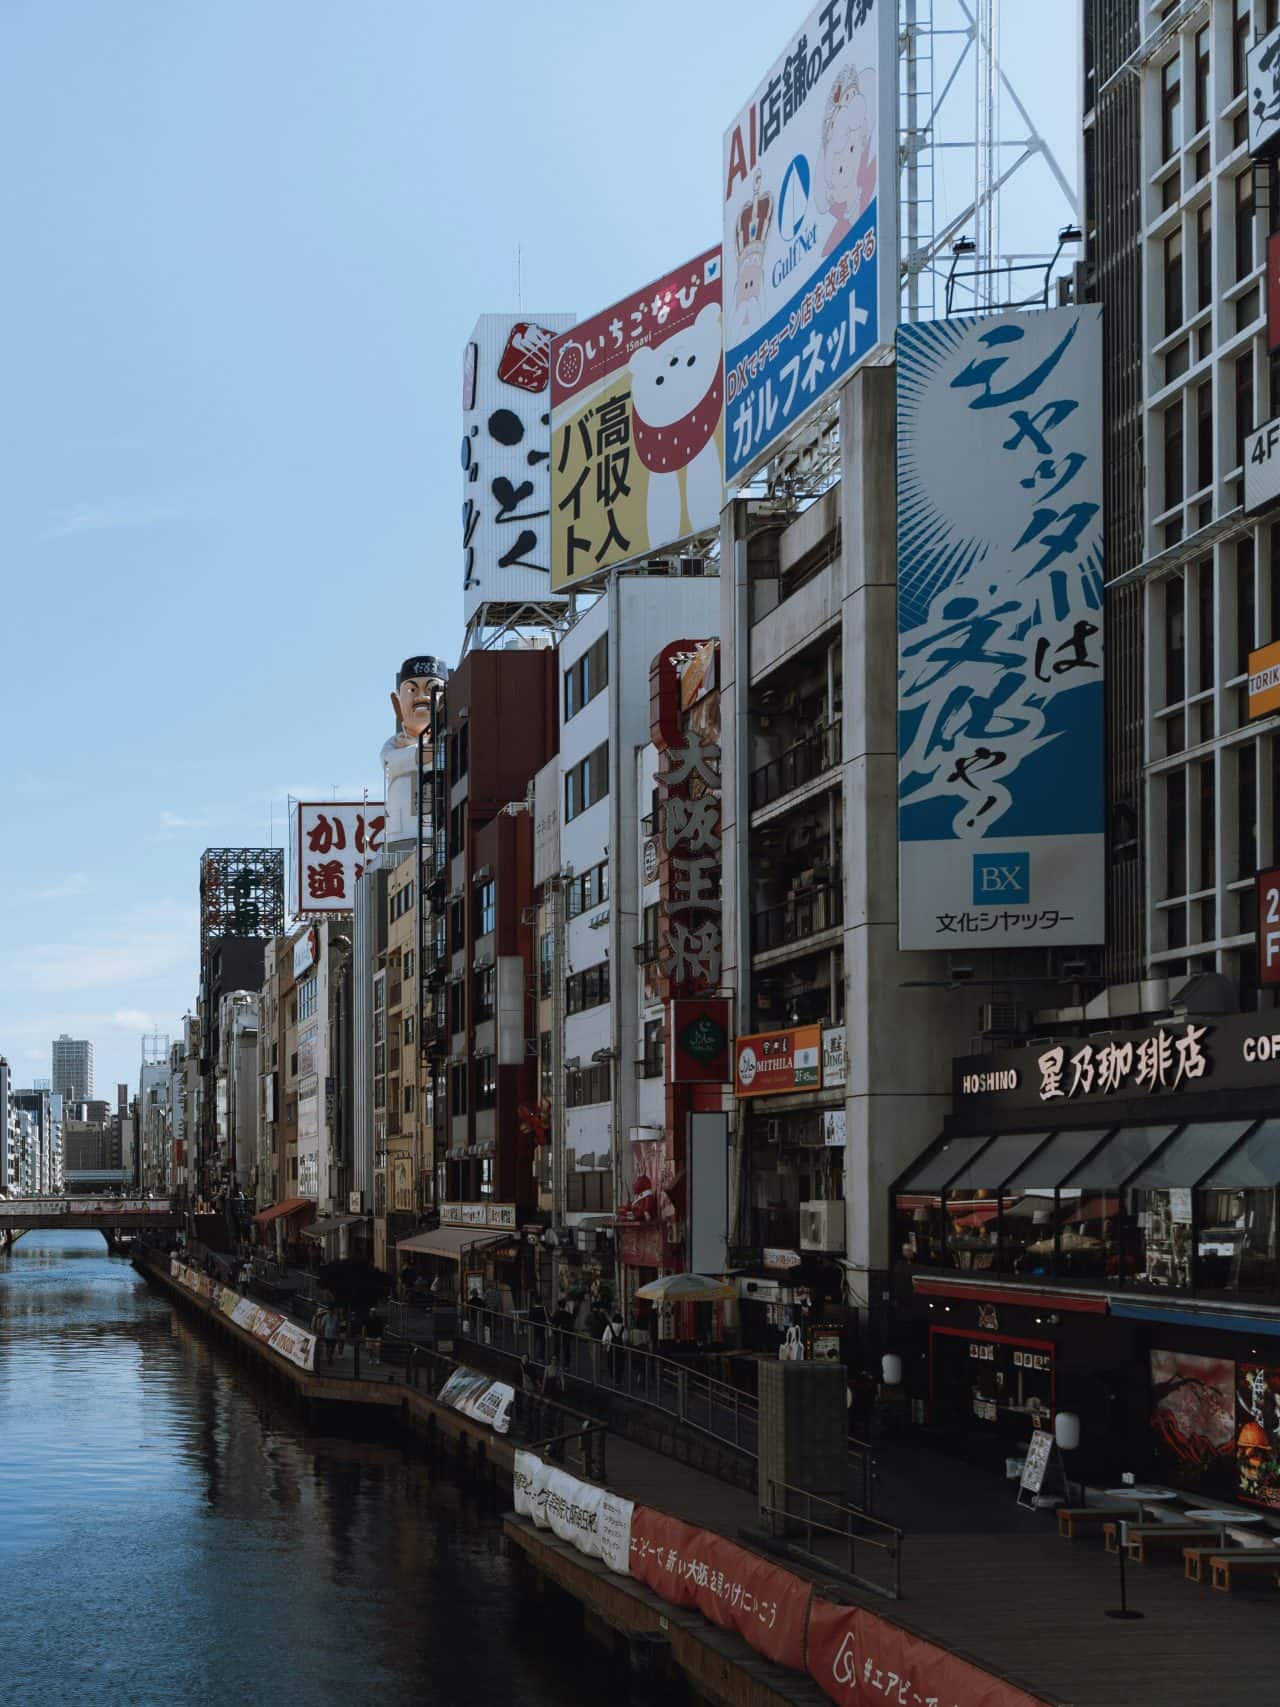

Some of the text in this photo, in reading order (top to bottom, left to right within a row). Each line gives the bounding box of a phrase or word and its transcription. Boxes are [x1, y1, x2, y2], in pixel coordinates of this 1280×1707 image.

[772, 222, 818, 289] GulfNet
[585, 274, 701, 360] いちごなび
[726, 229, 877, 404] DXでチェーン店を改革する
[732, 289, 870, 465] ガルフネット
[558, 410, 595, 577] バイト
[595, 391, 632, 563] 高収入
[306, 813, 385, 854] かに
[652, 732, 722, 984] 大阪王将
[307, 860, 375, 899] 道
[980, 865, 1023, 892] BX
[756, 1056, 793, 1073] MITHILA
[963, 1069, 1018, 1095] HOSHINO
[1037, 1024, 1208, 1101] 星乃珈琲店
